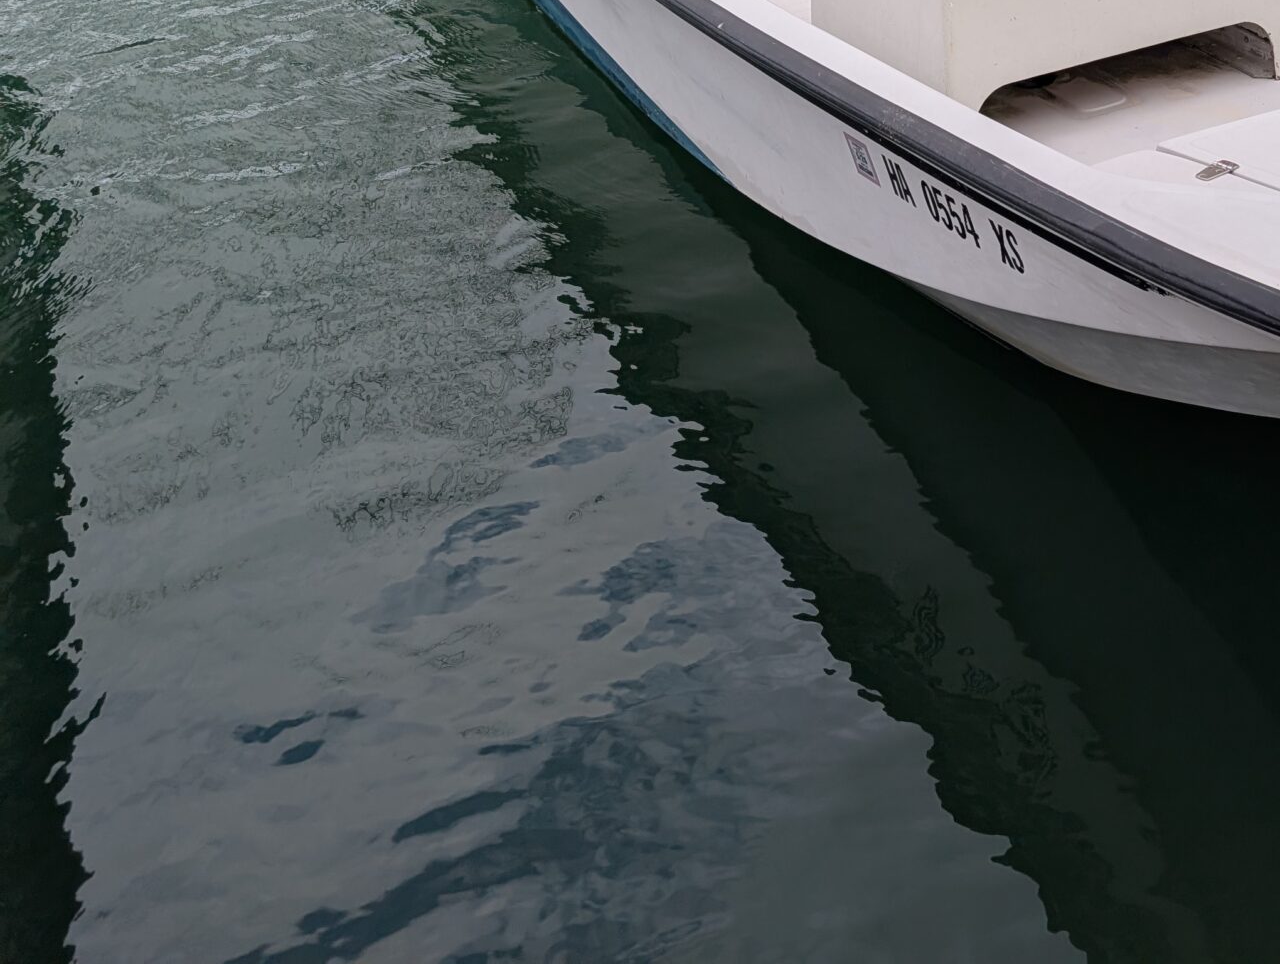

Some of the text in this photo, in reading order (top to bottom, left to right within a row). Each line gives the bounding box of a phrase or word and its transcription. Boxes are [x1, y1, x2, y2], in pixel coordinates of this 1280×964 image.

[881, 154, 918, 208] HA
[921, 180, 982, 250] 0554
[988, 218, 1025, 274] XS
